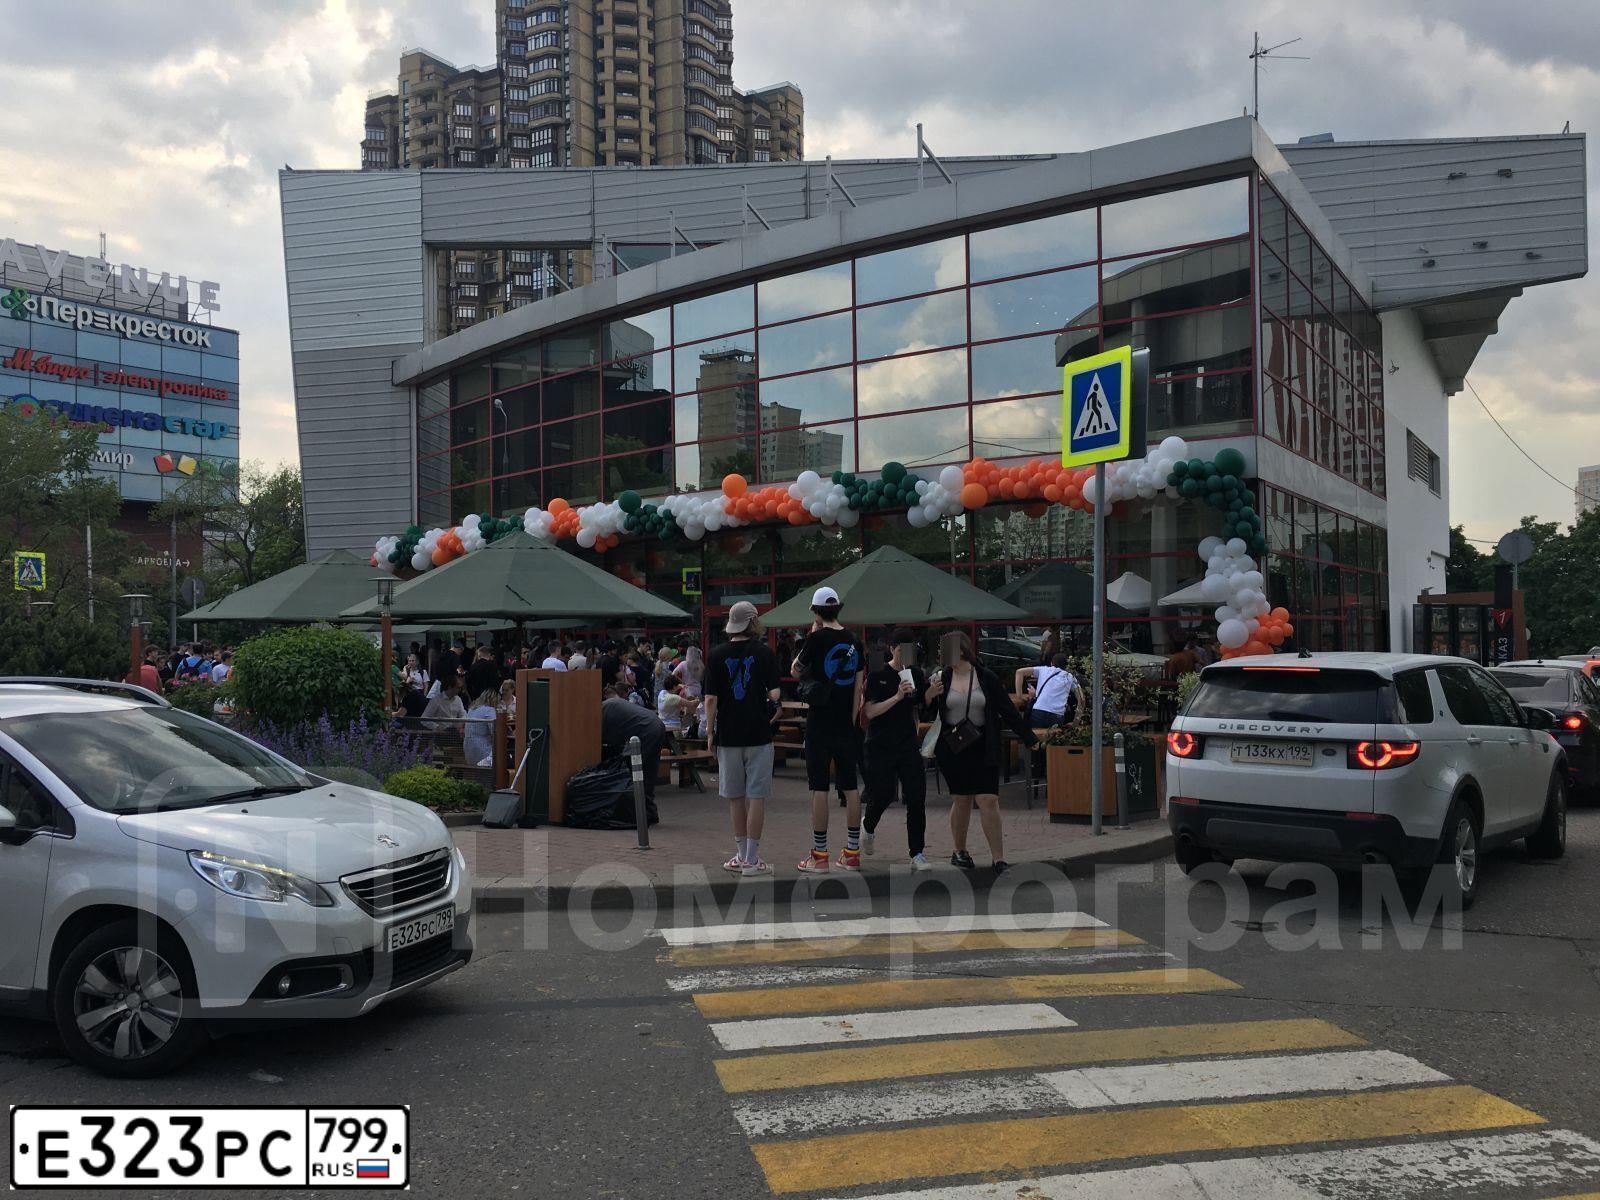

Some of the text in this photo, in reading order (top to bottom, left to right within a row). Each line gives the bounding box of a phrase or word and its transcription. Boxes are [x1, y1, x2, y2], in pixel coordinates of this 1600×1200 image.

[0, 237, 221, 312] AVENUE
[40, 296, 212, 347] Перекресток
[103, 370, 229, 400] электроника
[1498, 637, 1508, 662] КАЗ
[1218, 723, 1325, 735] DISCOVERY
